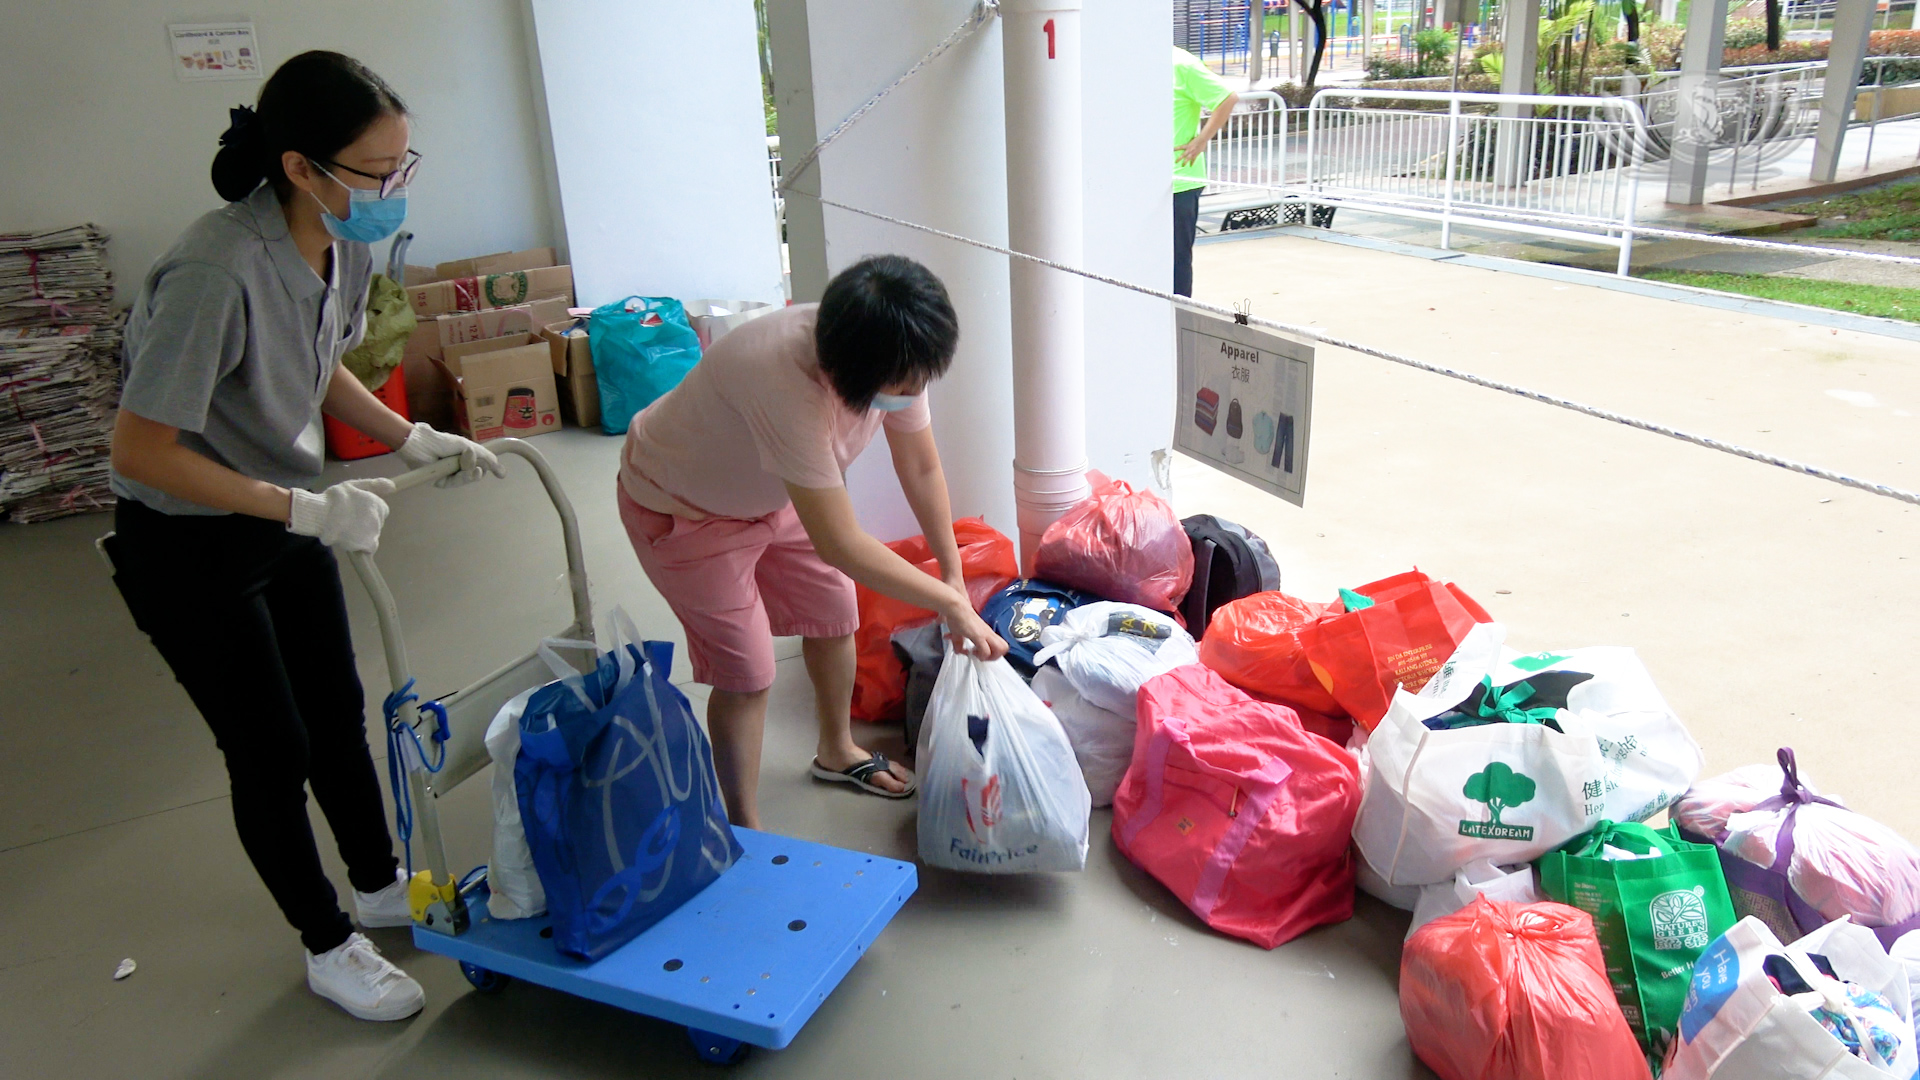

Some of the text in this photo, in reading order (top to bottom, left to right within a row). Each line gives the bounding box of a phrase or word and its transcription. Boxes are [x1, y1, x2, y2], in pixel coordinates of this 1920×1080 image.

[1043, 19, 1055, 59] 1
[1220, 341, 1259, 363] Apparel
[1231, 364, 1250, 383] 衣服
[1462, 823, 1531, 839] LATEXDREAM
[1656, 926, 1705, 938] GREEN
[1661, 966, 1685, 979] Better
[1713, 949, 1731, 984] Have
[1695, 966, 1711, 990] you
